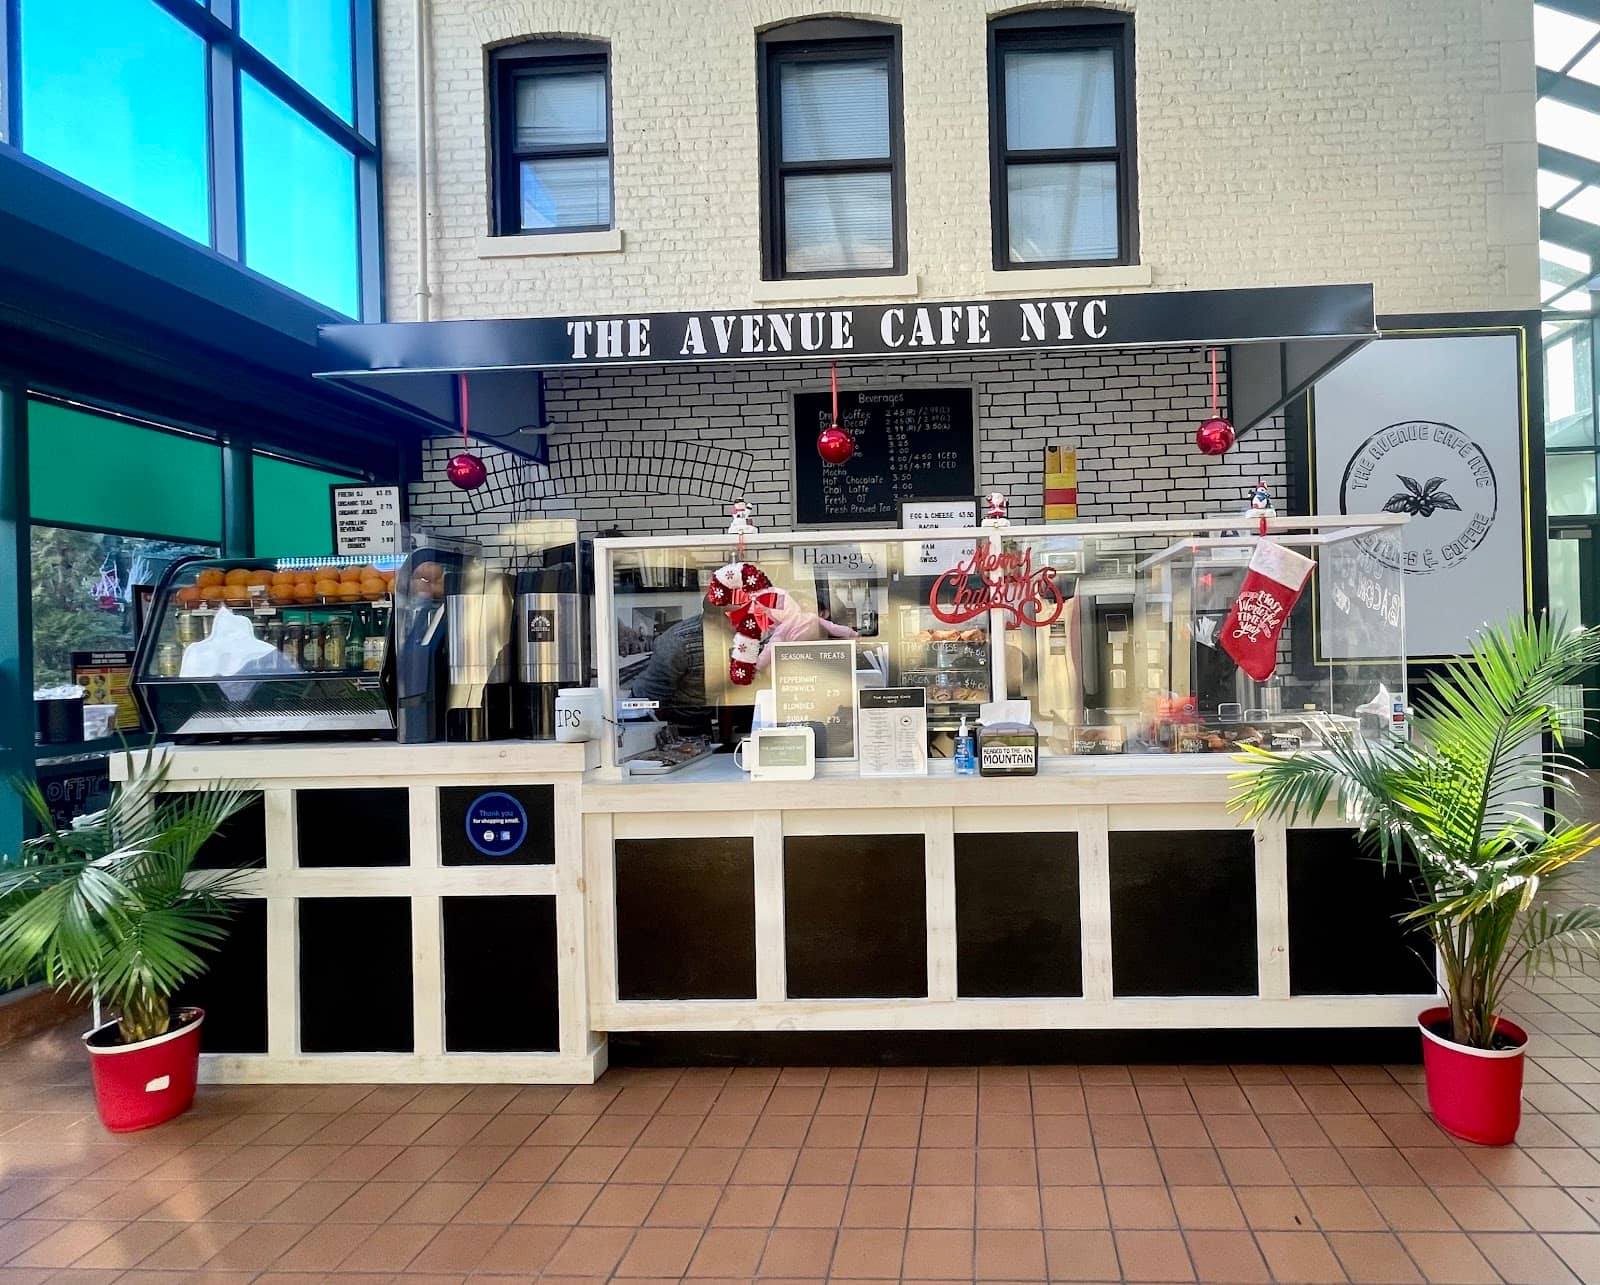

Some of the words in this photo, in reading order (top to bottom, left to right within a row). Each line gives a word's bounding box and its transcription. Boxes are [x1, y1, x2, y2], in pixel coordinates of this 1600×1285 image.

[567, 318, 651, 359] THE
[680, 311, 854, 356] AVENUE
[880, 304, 991, 348] CAFE
[1020, 299, 1108, 342] NYC
[859, 393, 904, 408] Beverages
[938, 451, 958, 460] ICED
[1352, 458, 1375, 490] THE
[1368, 424, 1429, 460] AVENUE
[1433, 427, 1473, 458] CAFE
[1467, 455, 1492, 488] NYC
[938, 461, 957, 469] ICED
[824, 494, 847, 504] Fresh
[825, 505, 848, 514] Fresh
[1441, 512, 1490, 561] COFFEE
[819, 652, 846, 660] TREATS
[983, 754, 1033, 765] MOUNTAIN
[479, 809, 500, 817] Thank
